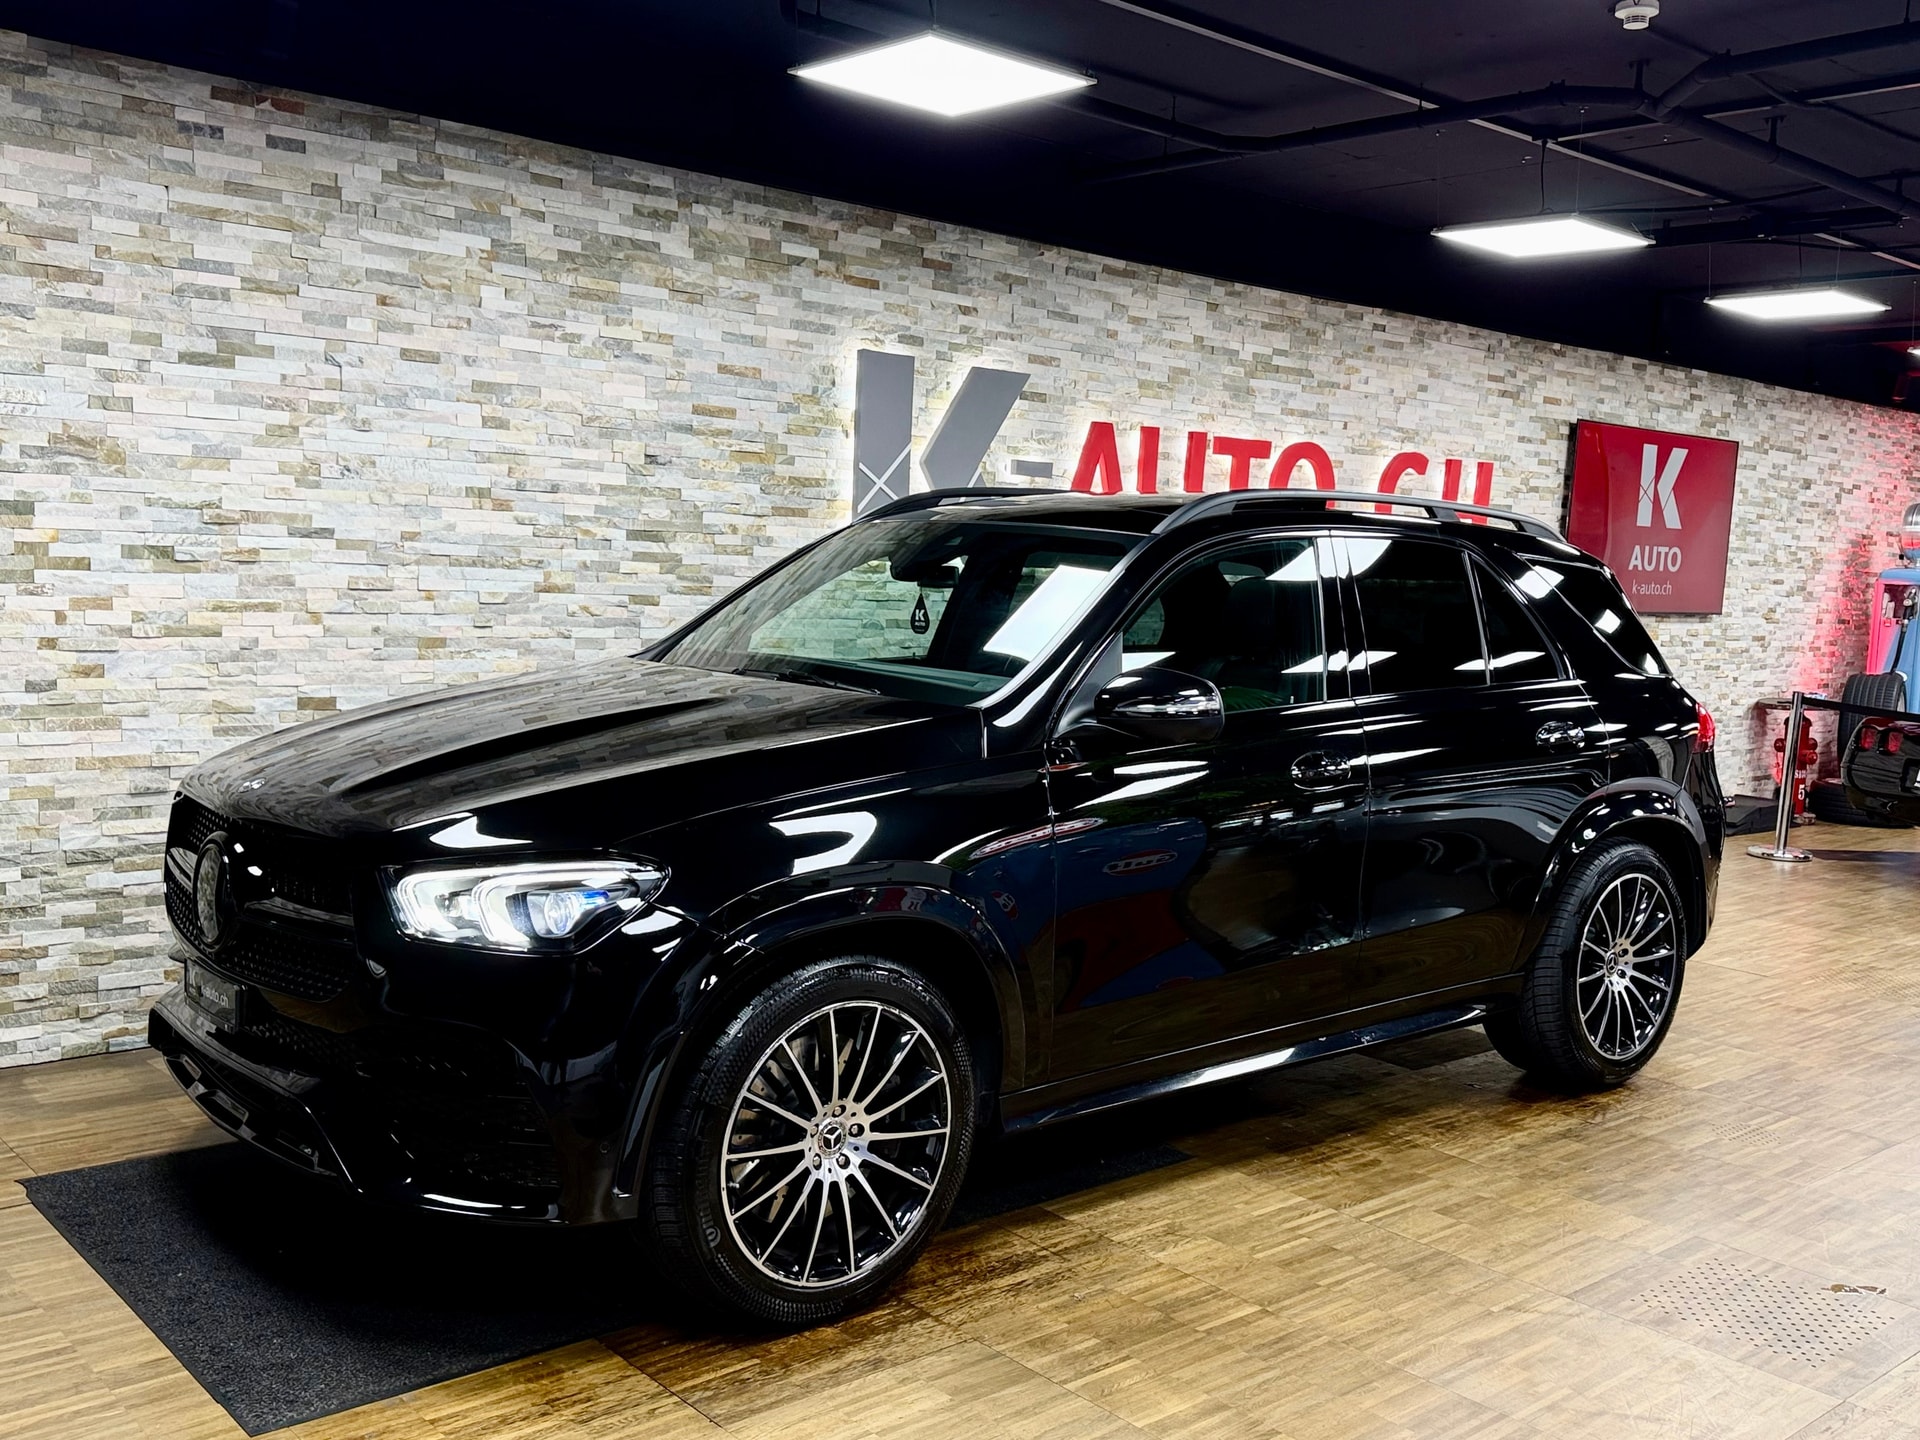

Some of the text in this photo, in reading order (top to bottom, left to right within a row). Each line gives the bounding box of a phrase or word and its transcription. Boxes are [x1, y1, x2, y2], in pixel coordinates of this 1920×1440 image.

[853, 349, 1494, 525] K-AUTOCH
[1636, 443, 1689, 530] K
[1628, 545, 1682, 572] AUTO
[1631, 580, 1673, 596] k-auto.ch
[915, 609, 925, 621] K
[1797, 784, 1806, 801] 5
